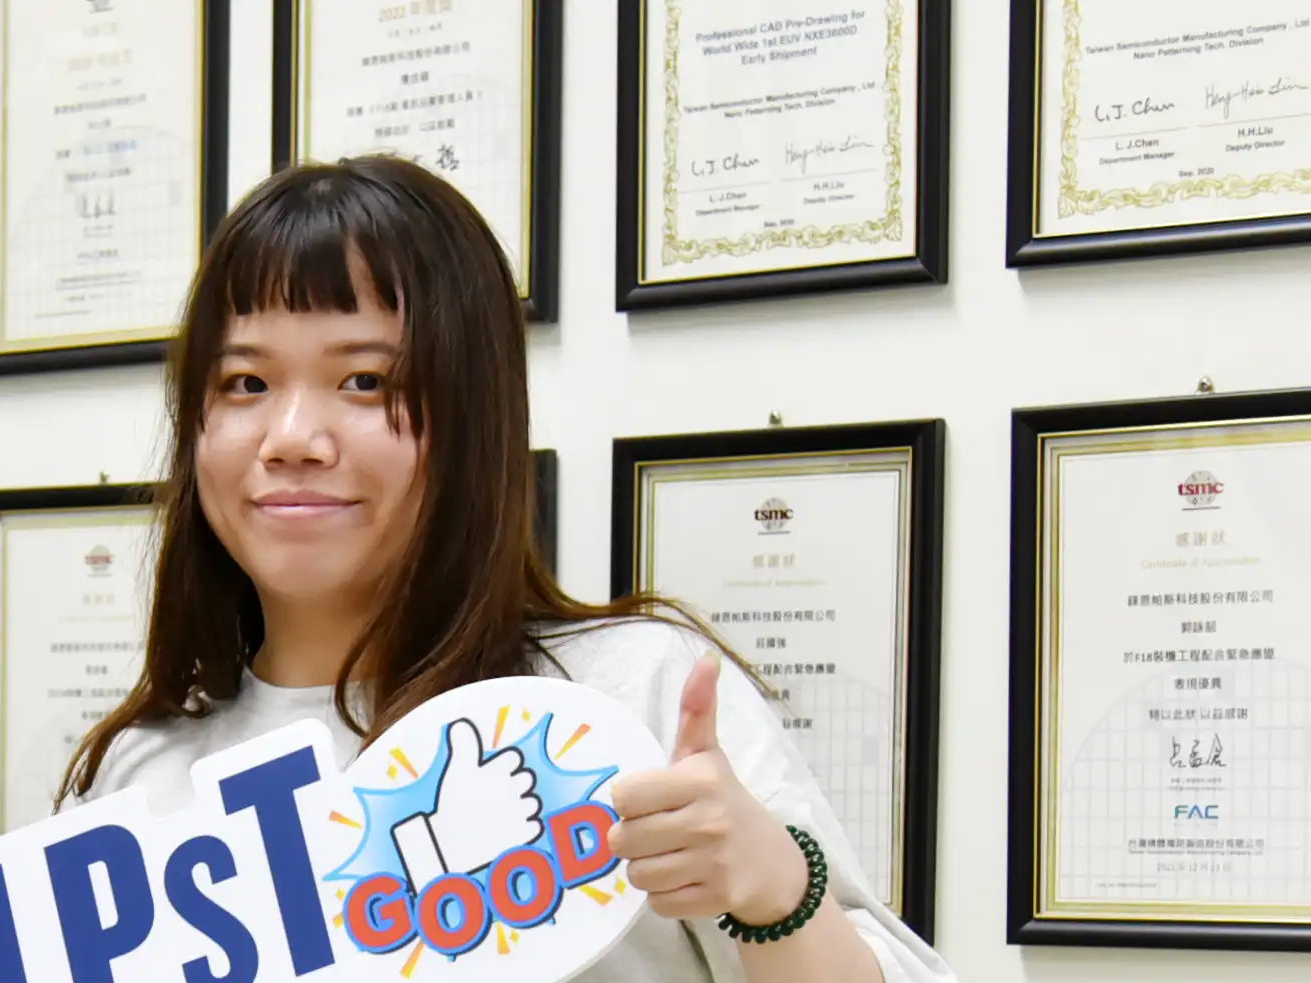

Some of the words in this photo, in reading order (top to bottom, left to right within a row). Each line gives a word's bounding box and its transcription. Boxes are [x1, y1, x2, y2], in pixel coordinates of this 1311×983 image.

[695, 24, 757, 42] Professional
[760, 20, 782, 33] CAD
[785, 13, 848, 30] Pre-Drawing
[851, 10, 866, 20] for
[702, 43, 732, 56] World
[735, 38, 759, 50] Wide
[762, 36, 777, 47] 1st
[780, 34, 801, 45] EUV
[804, 25, 858, 41] NXE3600D
[1086, 44, 1114, 55] Taiwan
[1116, 36, 1180, 51] Semiconductor
[1182, 27, 1244, 42] Manufacturing
[1246, 22, 1287, 36] Company
[741, 53, 766, 65] Early
[769, 47, 817, 62] Shipment
[1133, 50, 1155, 60] Nano
[1158, 44, 1201, 57] Patterning
[1229, 37, 1264, 48] Division
[766, 88, 818, 102] Manufacturing
[820, 83, 855, 96] Company
[1225, 142, 1252, 153] Deputy
[1254, 139, 1285, 149] Director
[1099, 155, 1141, 166] Department
[1143, 150, 1175, 161] Manager
[1177, 482, 1225, 496] tsmc
[754, 508, 794, 521] tsmc
[1174, 804, 1219, 819] FAC
[343, 800, 621, 956] GOOD
